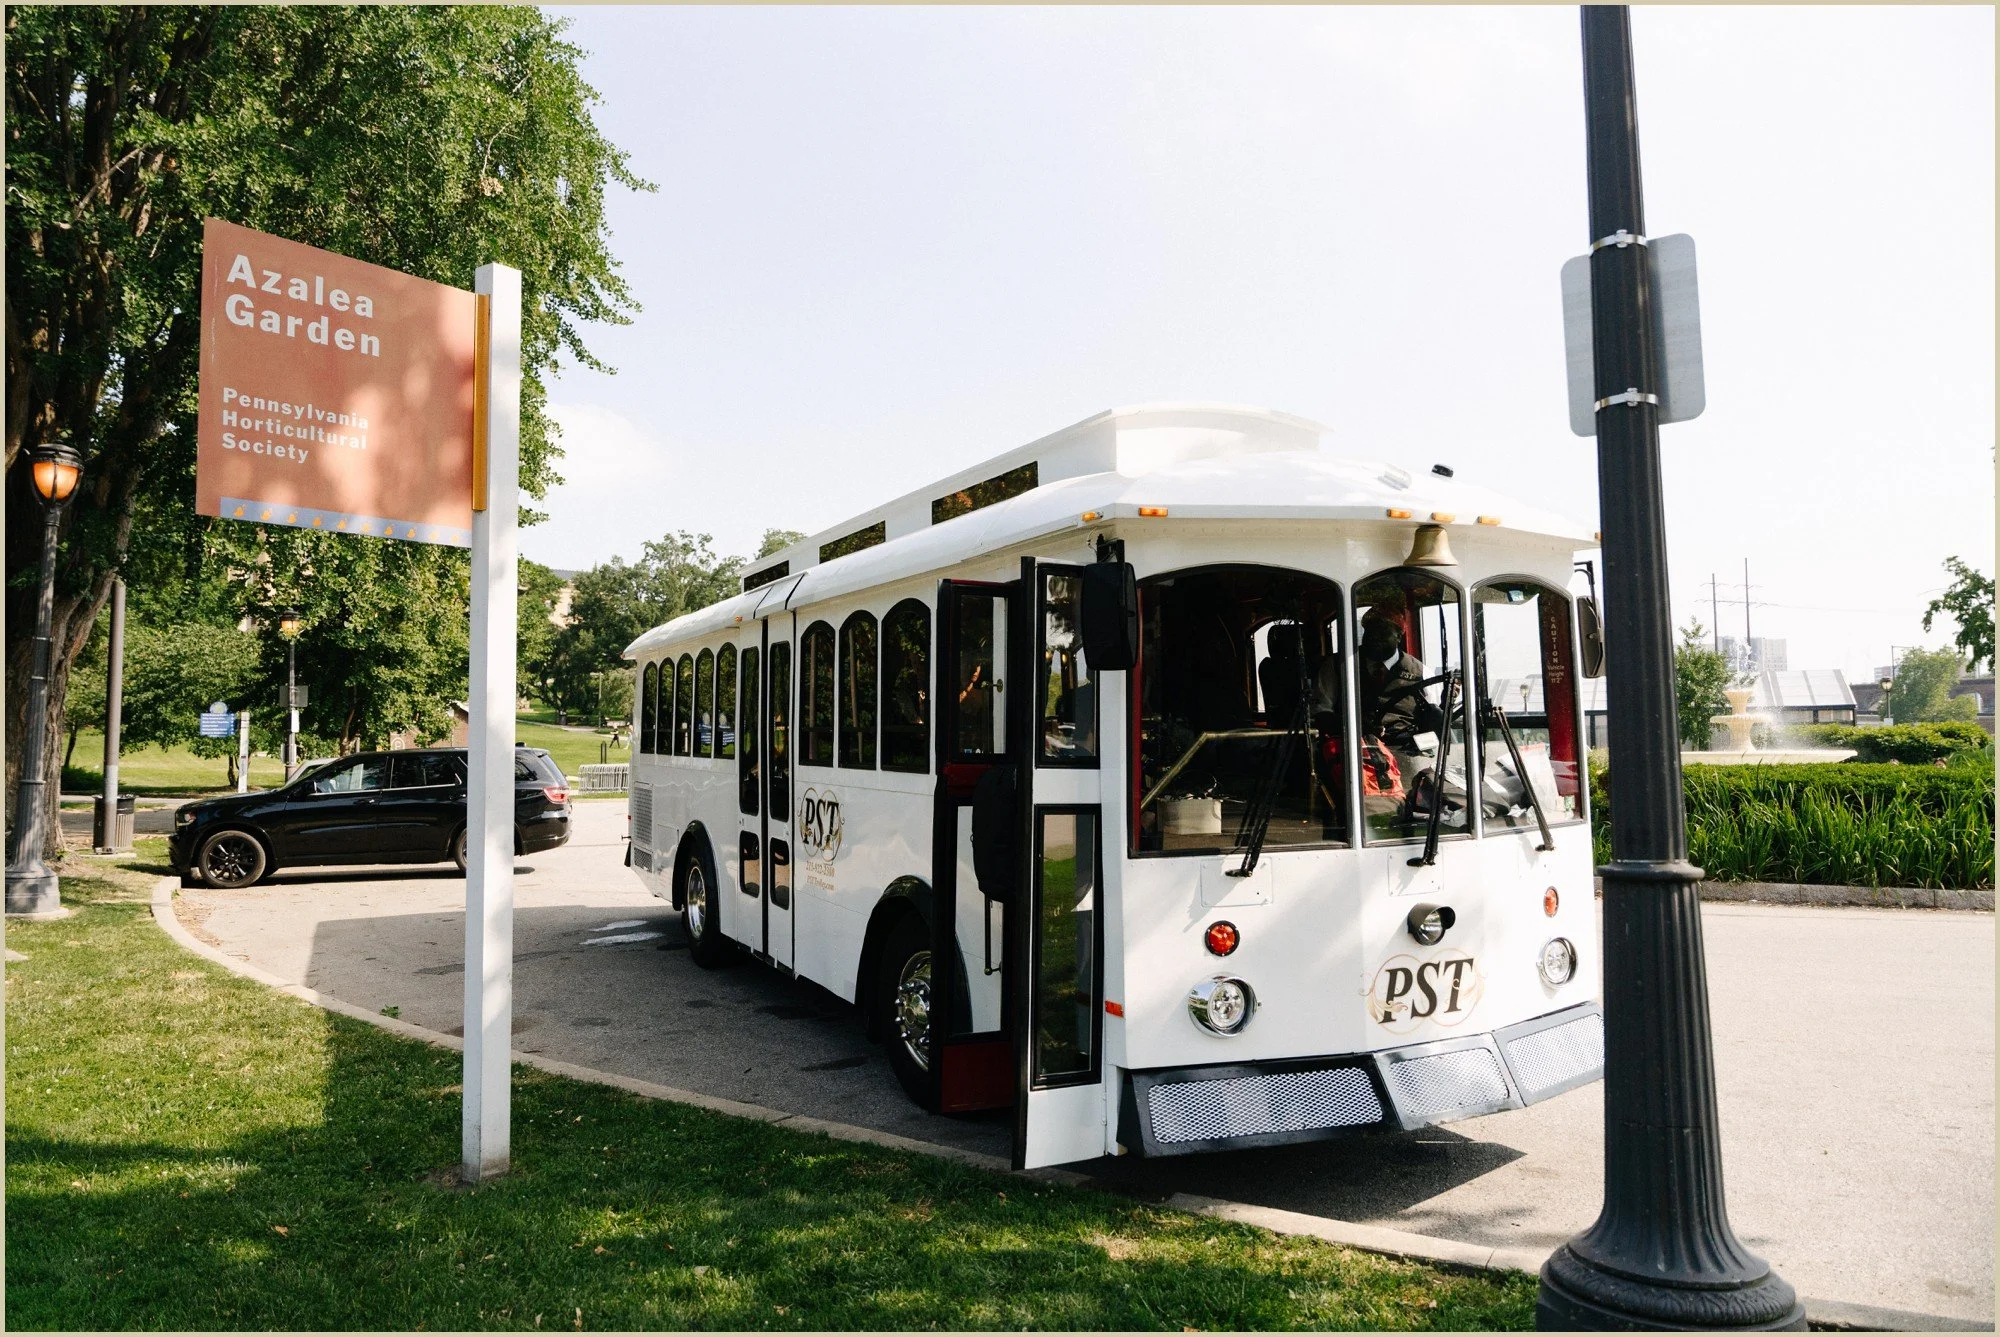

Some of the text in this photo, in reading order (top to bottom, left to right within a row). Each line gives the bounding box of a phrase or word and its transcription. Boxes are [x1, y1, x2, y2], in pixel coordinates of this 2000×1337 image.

[226, 254, 374, 317] Azalea
[225, 294, 380, 357] Garden
[222, 387, 369, 429] Pennsylvania
[222, 409, 367, 450] Horticultural
[222, 432, 309, 464] Society
[1550, 616, 1559, 663] CAUTION
[803, 797, 839, 848] PST
[1378, 958, 1474, 1024] PST
